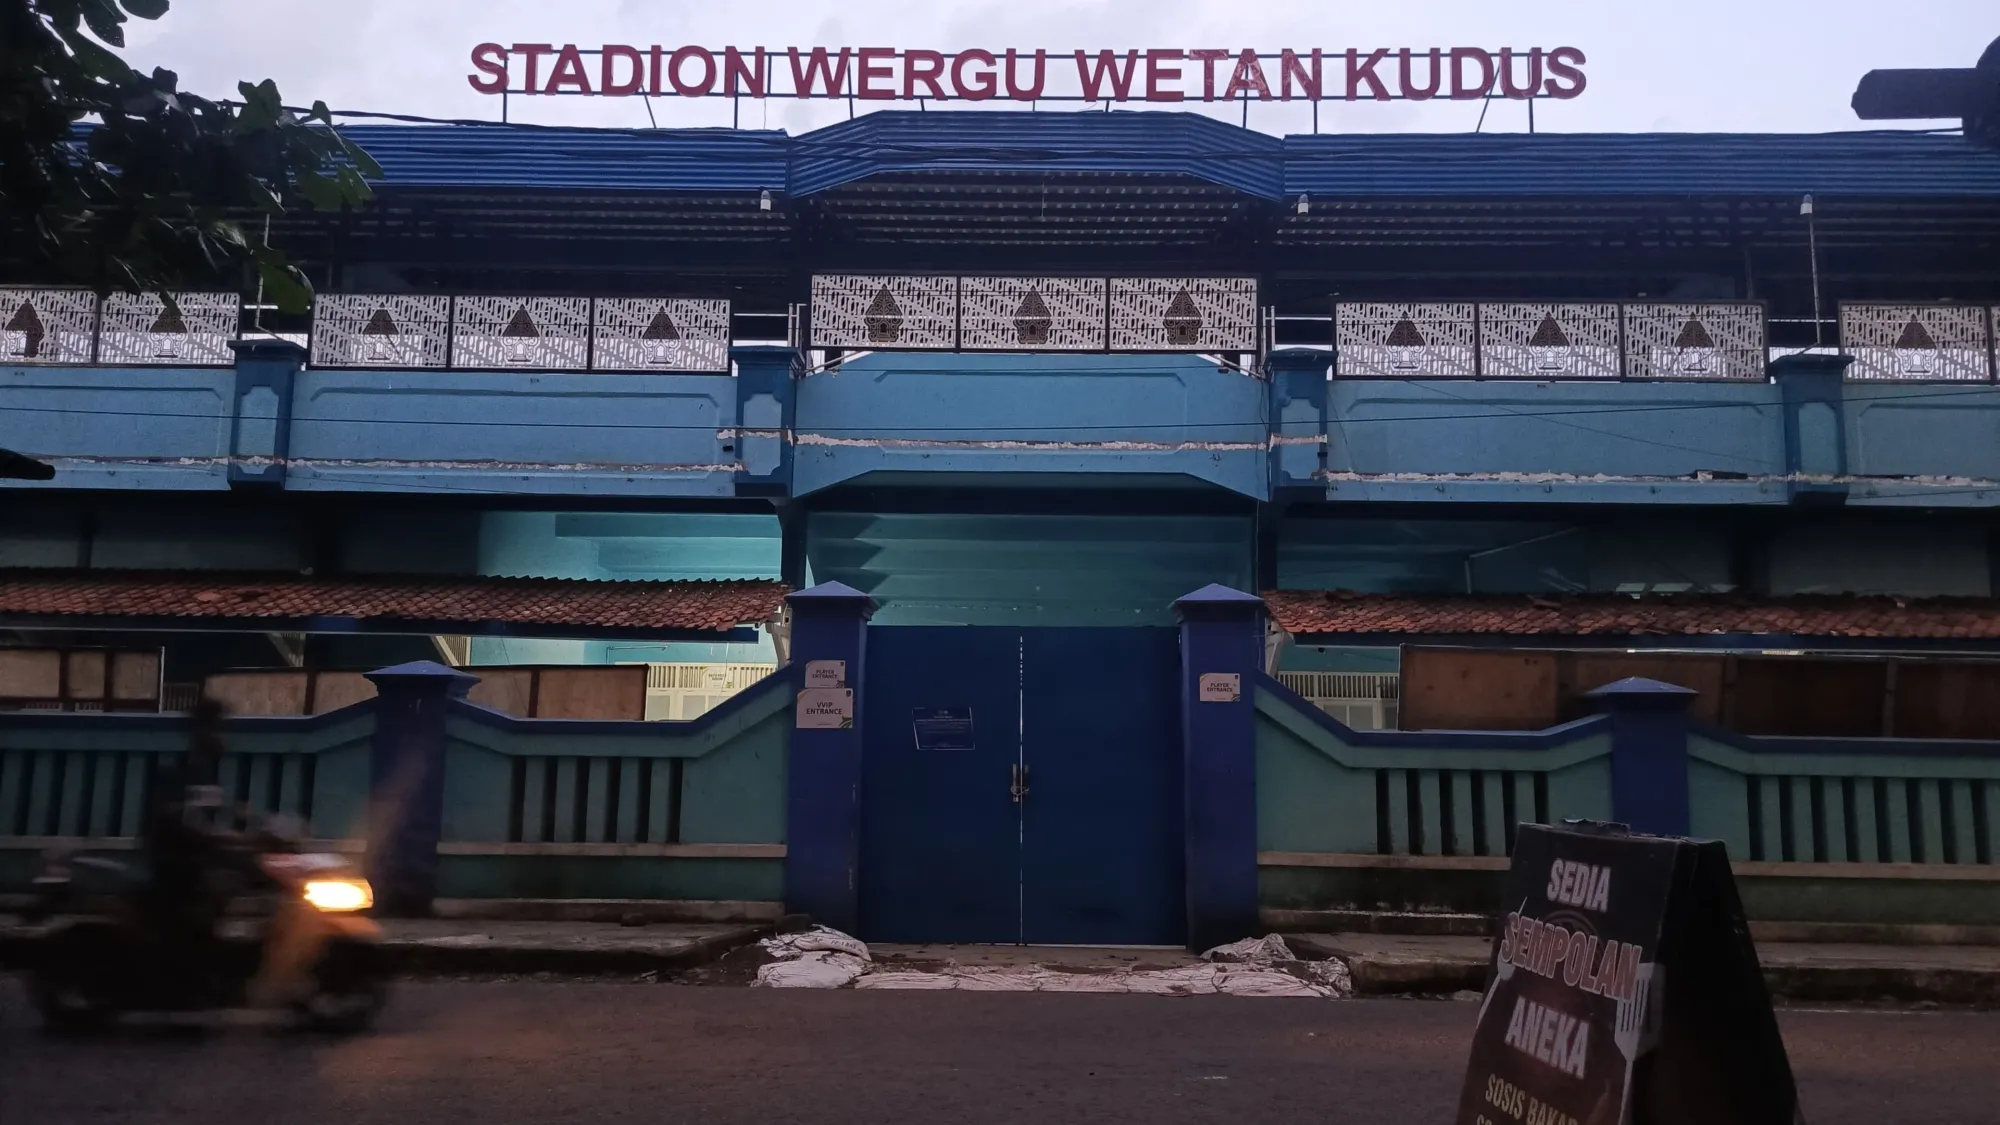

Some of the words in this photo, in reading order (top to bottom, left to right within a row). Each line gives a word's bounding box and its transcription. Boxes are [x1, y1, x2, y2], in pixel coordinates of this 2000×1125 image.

[467, 42, 766, 99] STADION
[787, 46, 1046, 102] WERGU
[1073, 47, 1323, 103] WETAN
[1344, 46, 1588, 102] KUDUS
[1546, 857, 1612, 914] SEDIA
[1499, 911, 1643, 1003] SEMPOLAN
[1504, 994, 1590, 1080] ANEKA
[1485, 1072, 1526, 1120] SOSIS
[1525, 1096, 1579, 1125] BAK
